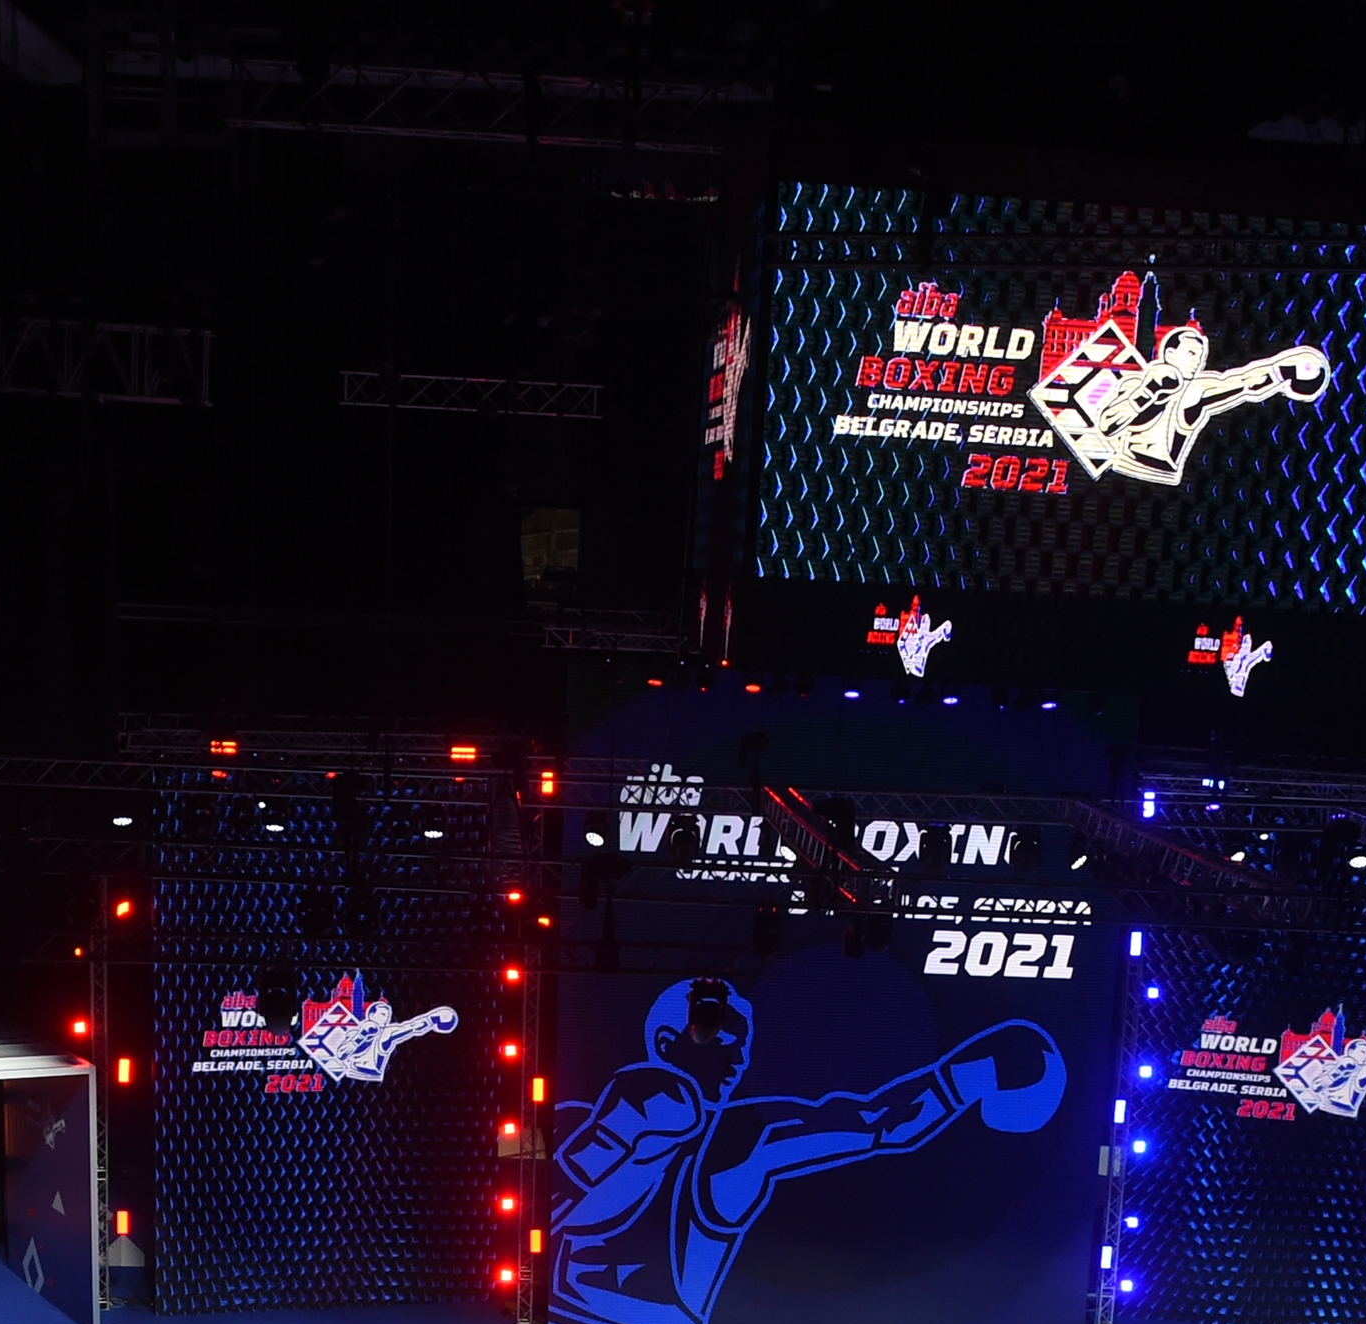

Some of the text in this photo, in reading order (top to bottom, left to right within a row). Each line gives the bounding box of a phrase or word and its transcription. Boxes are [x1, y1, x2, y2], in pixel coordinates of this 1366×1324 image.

[895, 282, 959, 318] aiba
[893, 320, 1035, 360] WORLD
[855, 356, 1016, 396] BOXING
[867, 393, 1025, 418] CHAMPIONSHIPS
[834, 414, 1054, 447] BELGRADE, SERBIA
[961, 453, 1070, 494] 2021
[620, 763, 704, 807] aiba
[923, 930, 1075, 980] 2021
[221, 991, 256, 1010] aiba
[1202, 1015, 1238, 1033] aiba
[203, 1030, 290, 1048] BOXING
[1200, 1033, 1278, 1055] WORLD
[210, 1047, 296, 1058] CHAMPIONSHIPS
[1180, 1050, 1267, 1072] BOXING
[192, 1059, 314, 1073] BELGRADE, SERBIA
[1186, 1068, 1271, 1083] CHAMPIONSHIPS
[264, 1074, 324, 1094] 2021
[1168, 1078, 1287, 1098] BELGRADE, SERBIA
[1236, 1099, 1296, 1121] 2021
